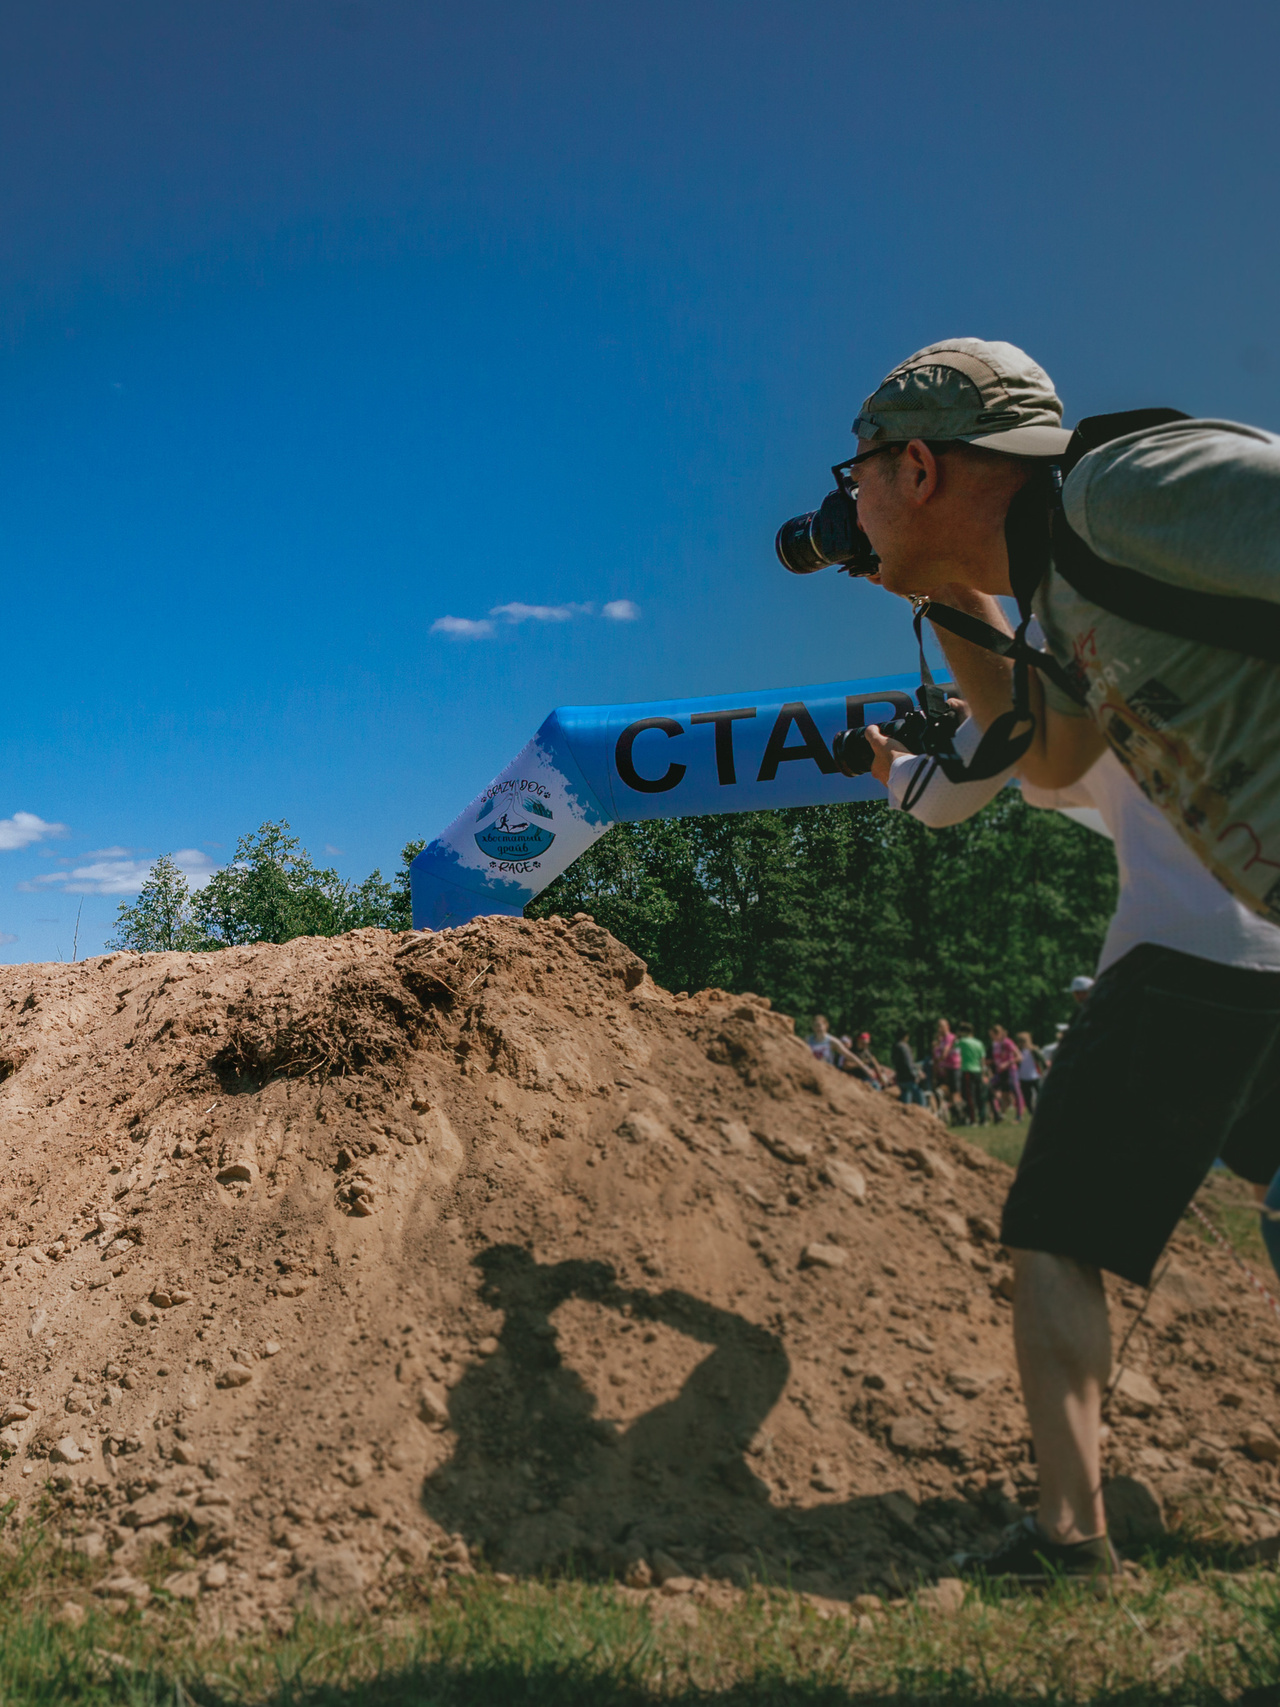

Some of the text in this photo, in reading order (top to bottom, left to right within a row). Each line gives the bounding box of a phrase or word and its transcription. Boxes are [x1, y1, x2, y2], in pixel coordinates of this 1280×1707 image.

[615, 684, 958, 793] СТАР
[486, 779, 546, 799] CRAZY DOG
[498, 861, 534, 875] RACE
